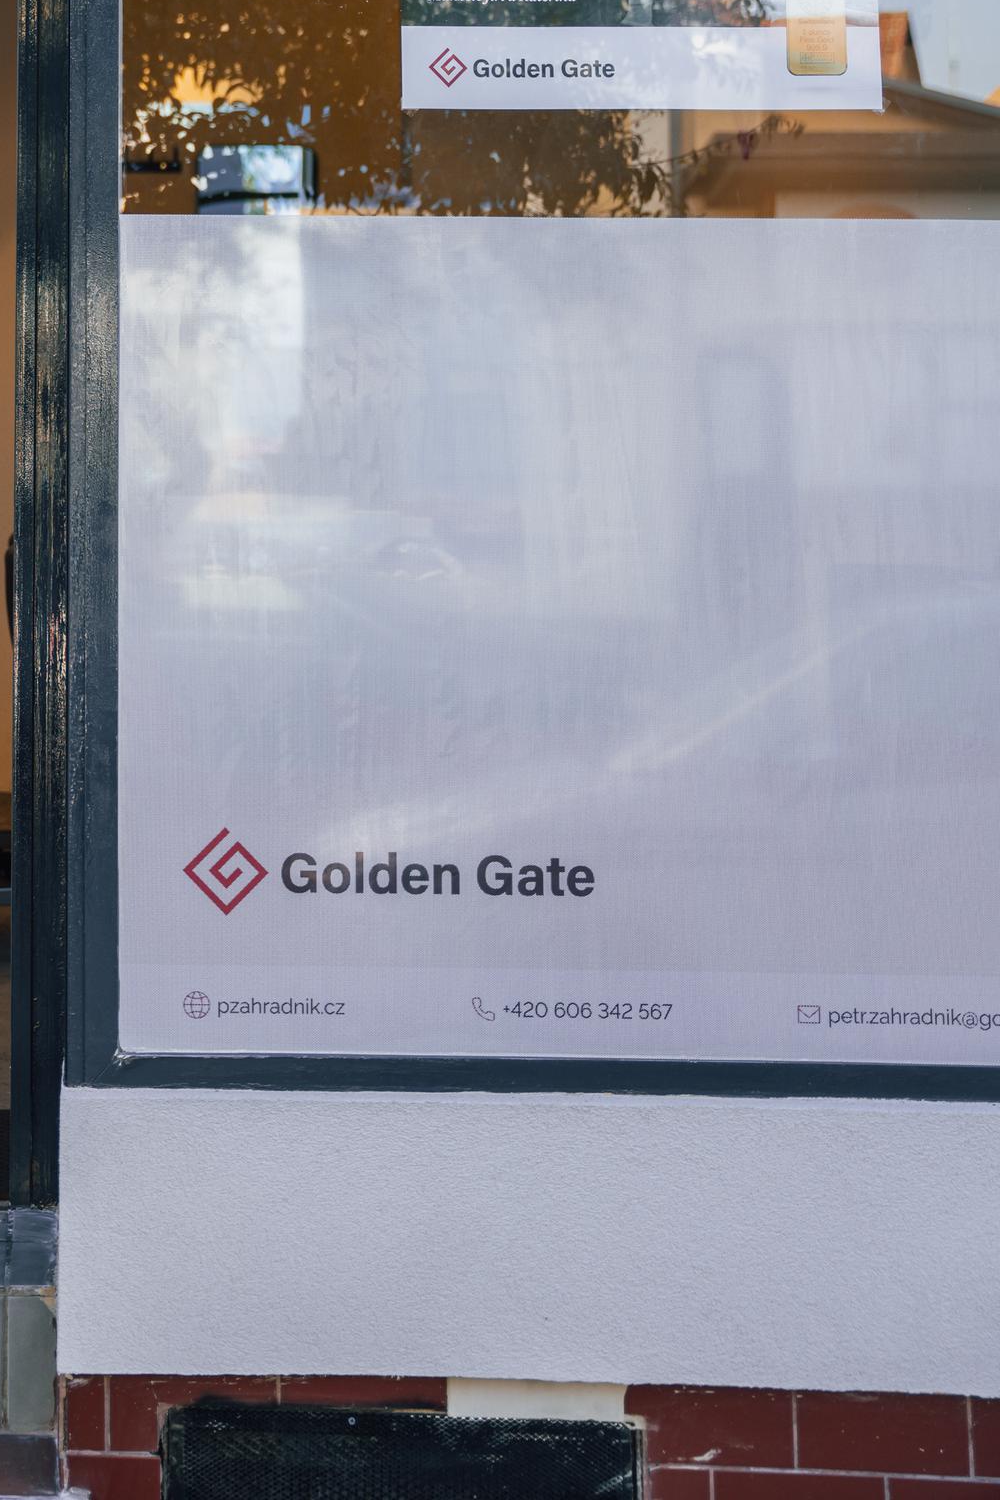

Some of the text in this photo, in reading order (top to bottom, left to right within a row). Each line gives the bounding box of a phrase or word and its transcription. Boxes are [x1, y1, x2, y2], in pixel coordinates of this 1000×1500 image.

[472, 58, 616, 79] Golden Gate
[281, 851, 595, 897] Golden Gate
[216, 997, 346, 1017] pzahradnik.cz
[503, 1001, 673, 1021] +420 606 342 567
